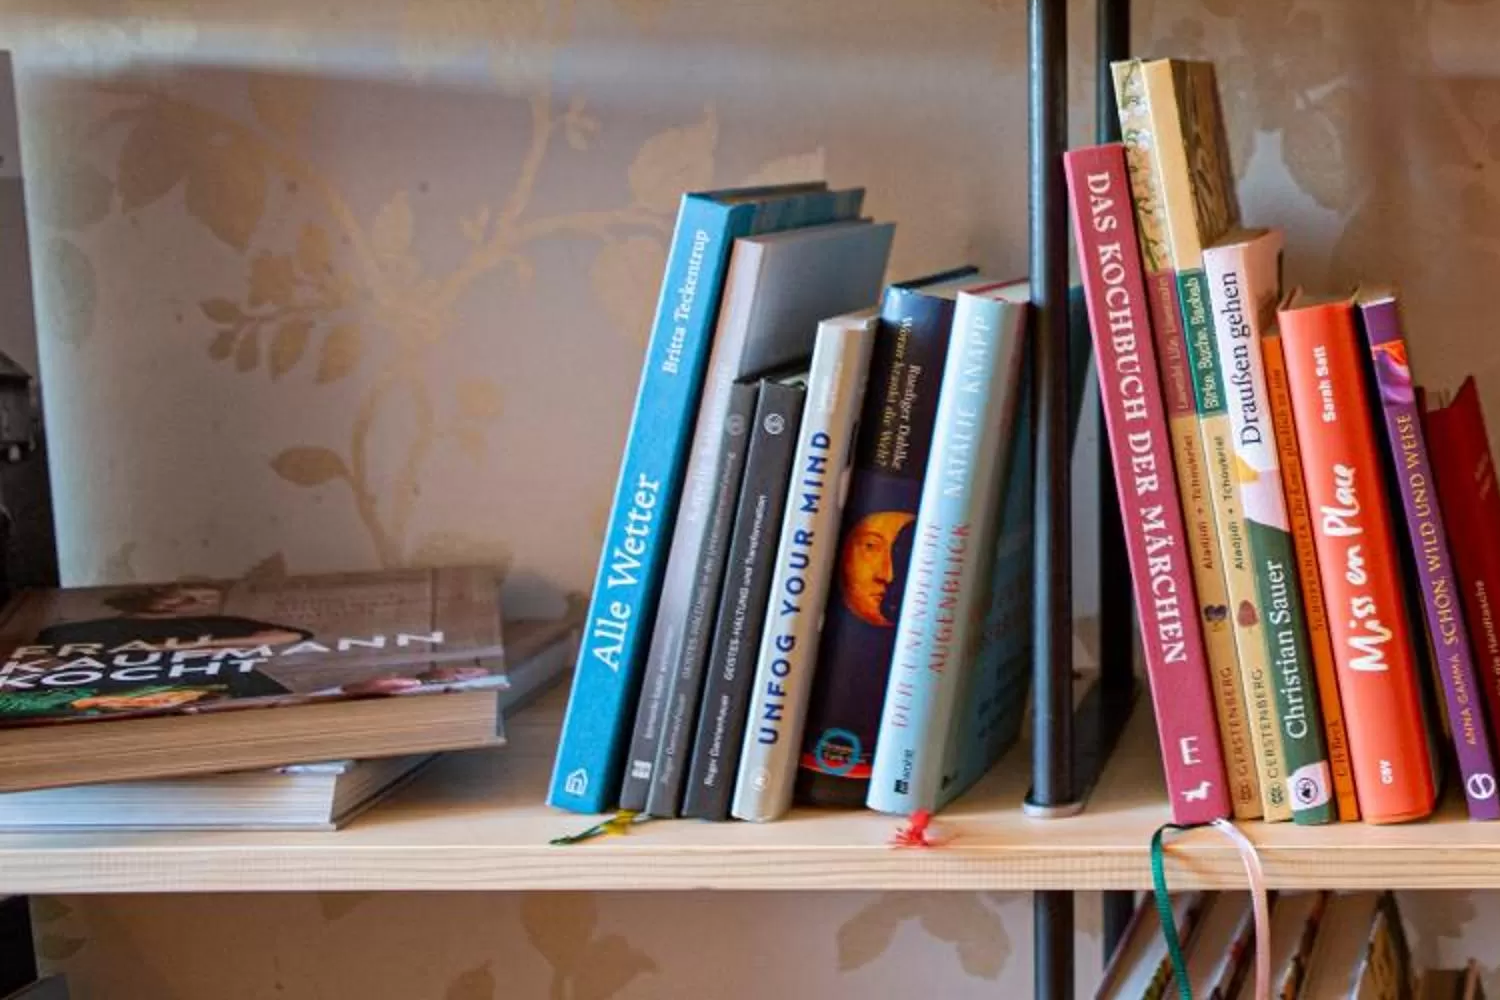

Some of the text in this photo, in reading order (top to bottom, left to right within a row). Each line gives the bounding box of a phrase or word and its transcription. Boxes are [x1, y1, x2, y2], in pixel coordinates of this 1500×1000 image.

[662, 228, 710, 376] Britta Teckentrup
[943, 314, 991, 498] NATALIE KNAPP
[1086, 171, 1188, 665] DAS KOCHBUCH DER MÄRCHEN
[1312, 344, 1338, 423] Sarah Satt
[605, 470, 660, 590] Wetter
[743, 495, 768, 565] Transformation
[1219, 272, 1309, 740] Christian Sauer Draußen gehen
[740, 566, 753, 586] und
[758, 634, 796, 746] UNFOG
[780, 529, 815, 617] YOUR
[799, 431, 831, 514] MIND
[928, 523, 971, 673] AUGENBLICK
[1320, 463, 1393, 672] Miss en Place
[1396, 413, 1477, 746] ANNA GAMMA WILD UND WEISE
[1474, 580, 1500, 654] Handtasche
[0, 630, 444, 673] KAUFMANN
[0, 657, 268, 689] KOCHT
[12, 635, 215, 659] FRAU
[590, 600, 632, 672] Alle
[703, 758, 719, 786] Roger
[1219, 665, 1250, 777] GERSTENBERG
[1250, 667, 1279, 779] GERSTENBERG
